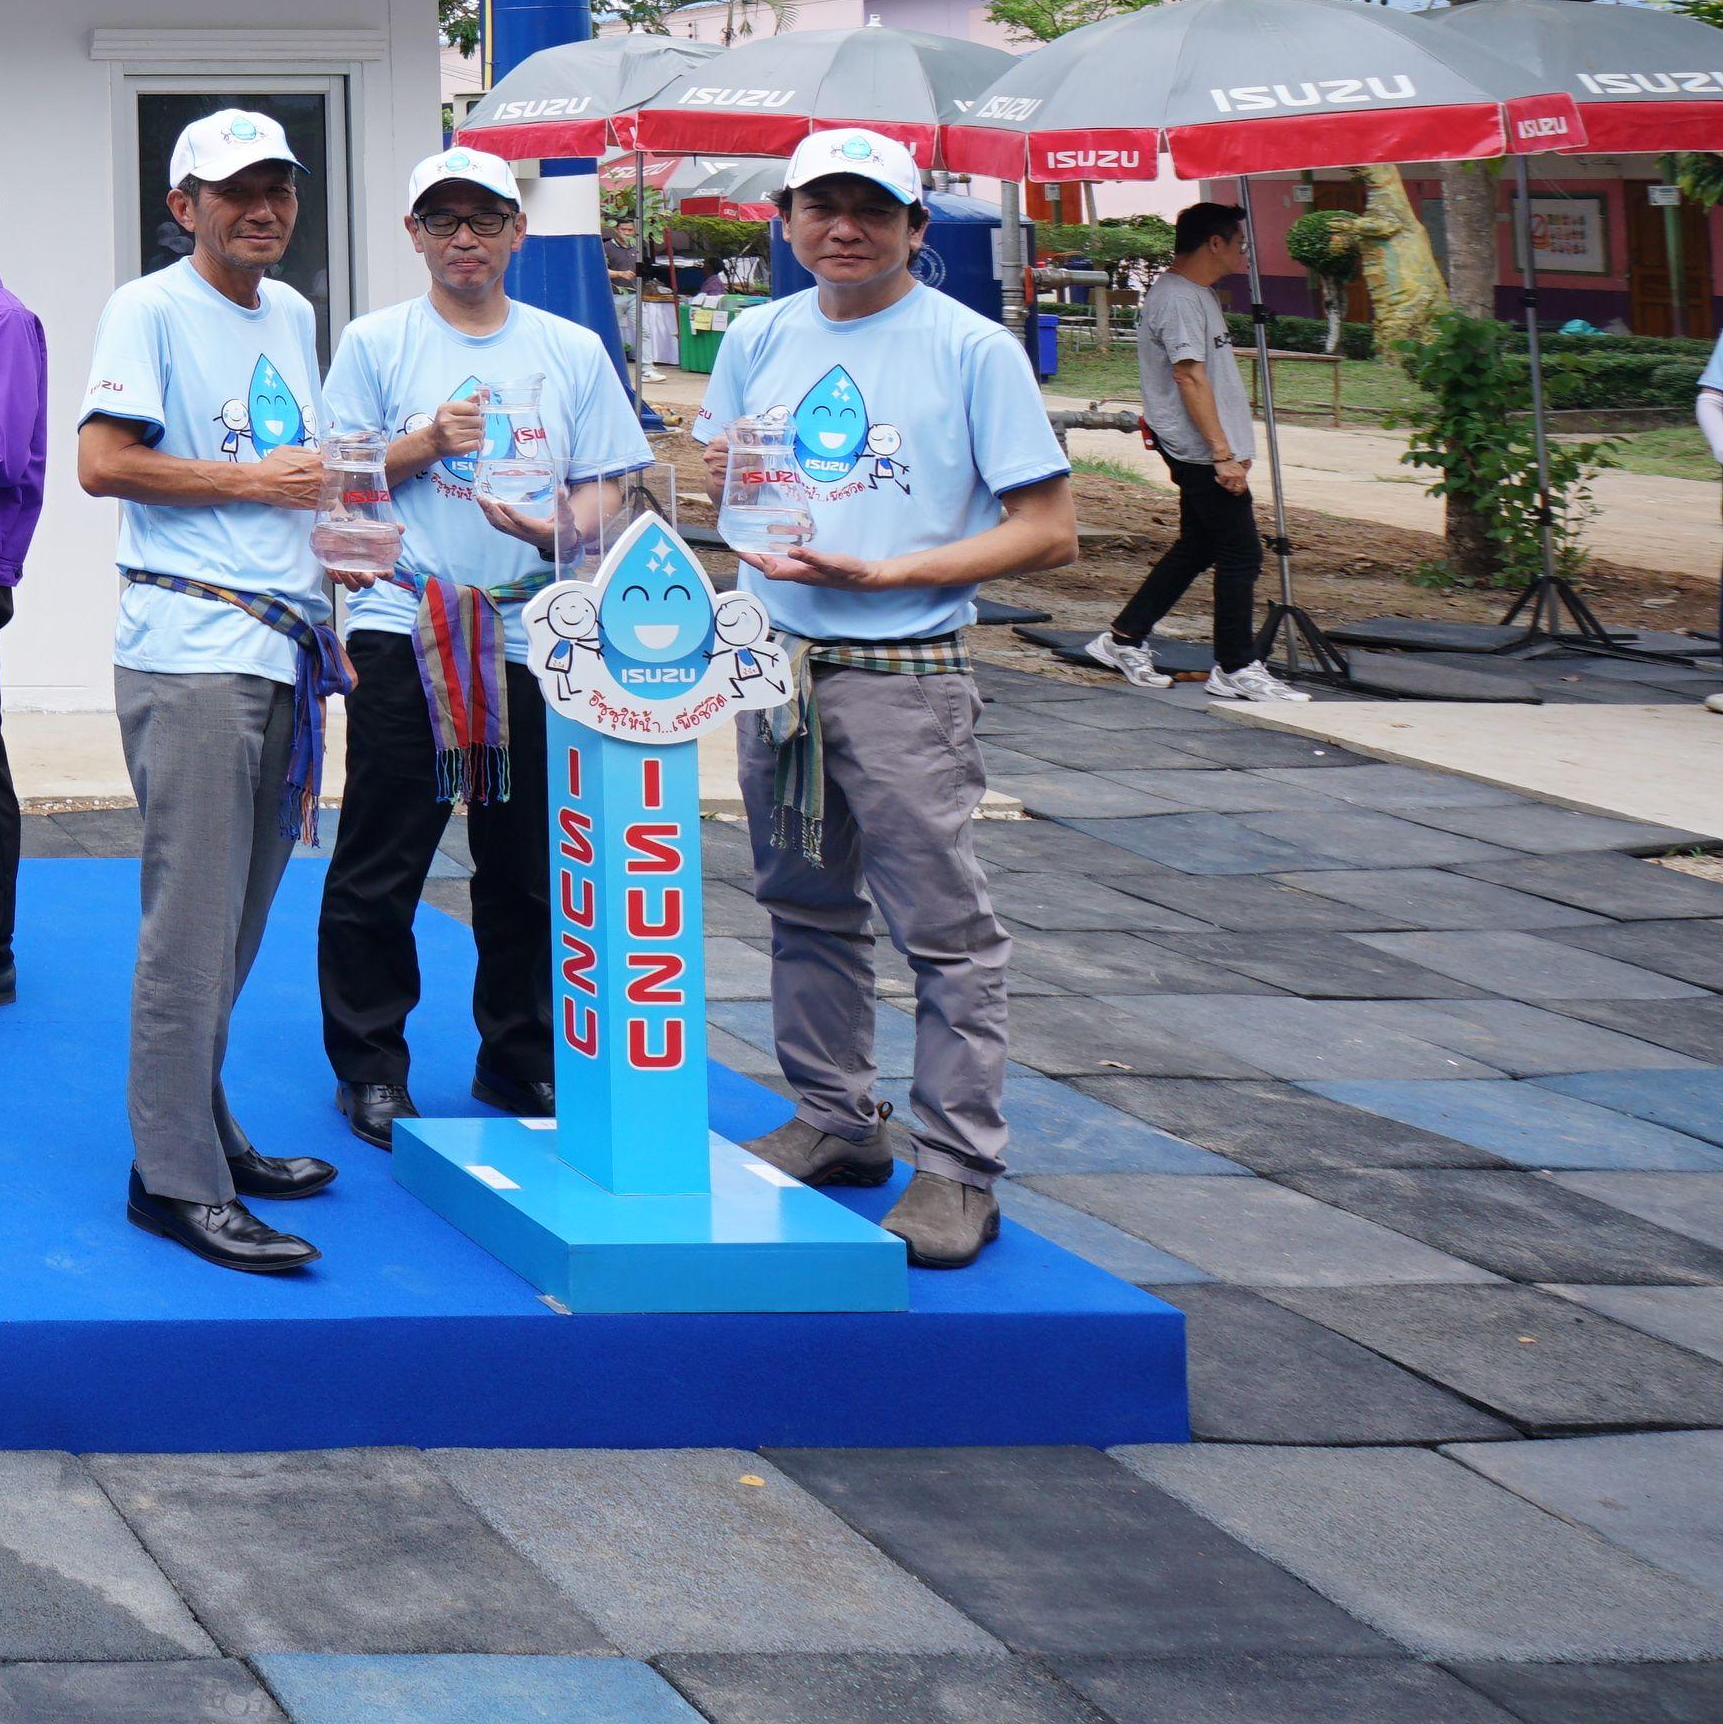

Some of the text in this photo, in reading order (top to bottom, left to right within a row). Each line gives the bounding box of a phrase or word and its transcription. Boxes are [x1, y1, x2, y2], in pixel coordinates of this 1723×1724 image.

[678, 87, 796, 107] ISUZU
[1209, 74, 1417, 113] ISUZU
[492, 97, 592, 120] ISUZU
[975, 96, 1043, 122] ISUZU
[1518, 116, 1568, 139] ISUZU
[1046, 150, 1140, 169] ISUZU
[805, 458, 850, 472] ISUZU
[621, 667, 696, 684] ISUZU
[558, 746, 598, 1060] ISUZU
[624, 758, 686, 1071] ISUZU
